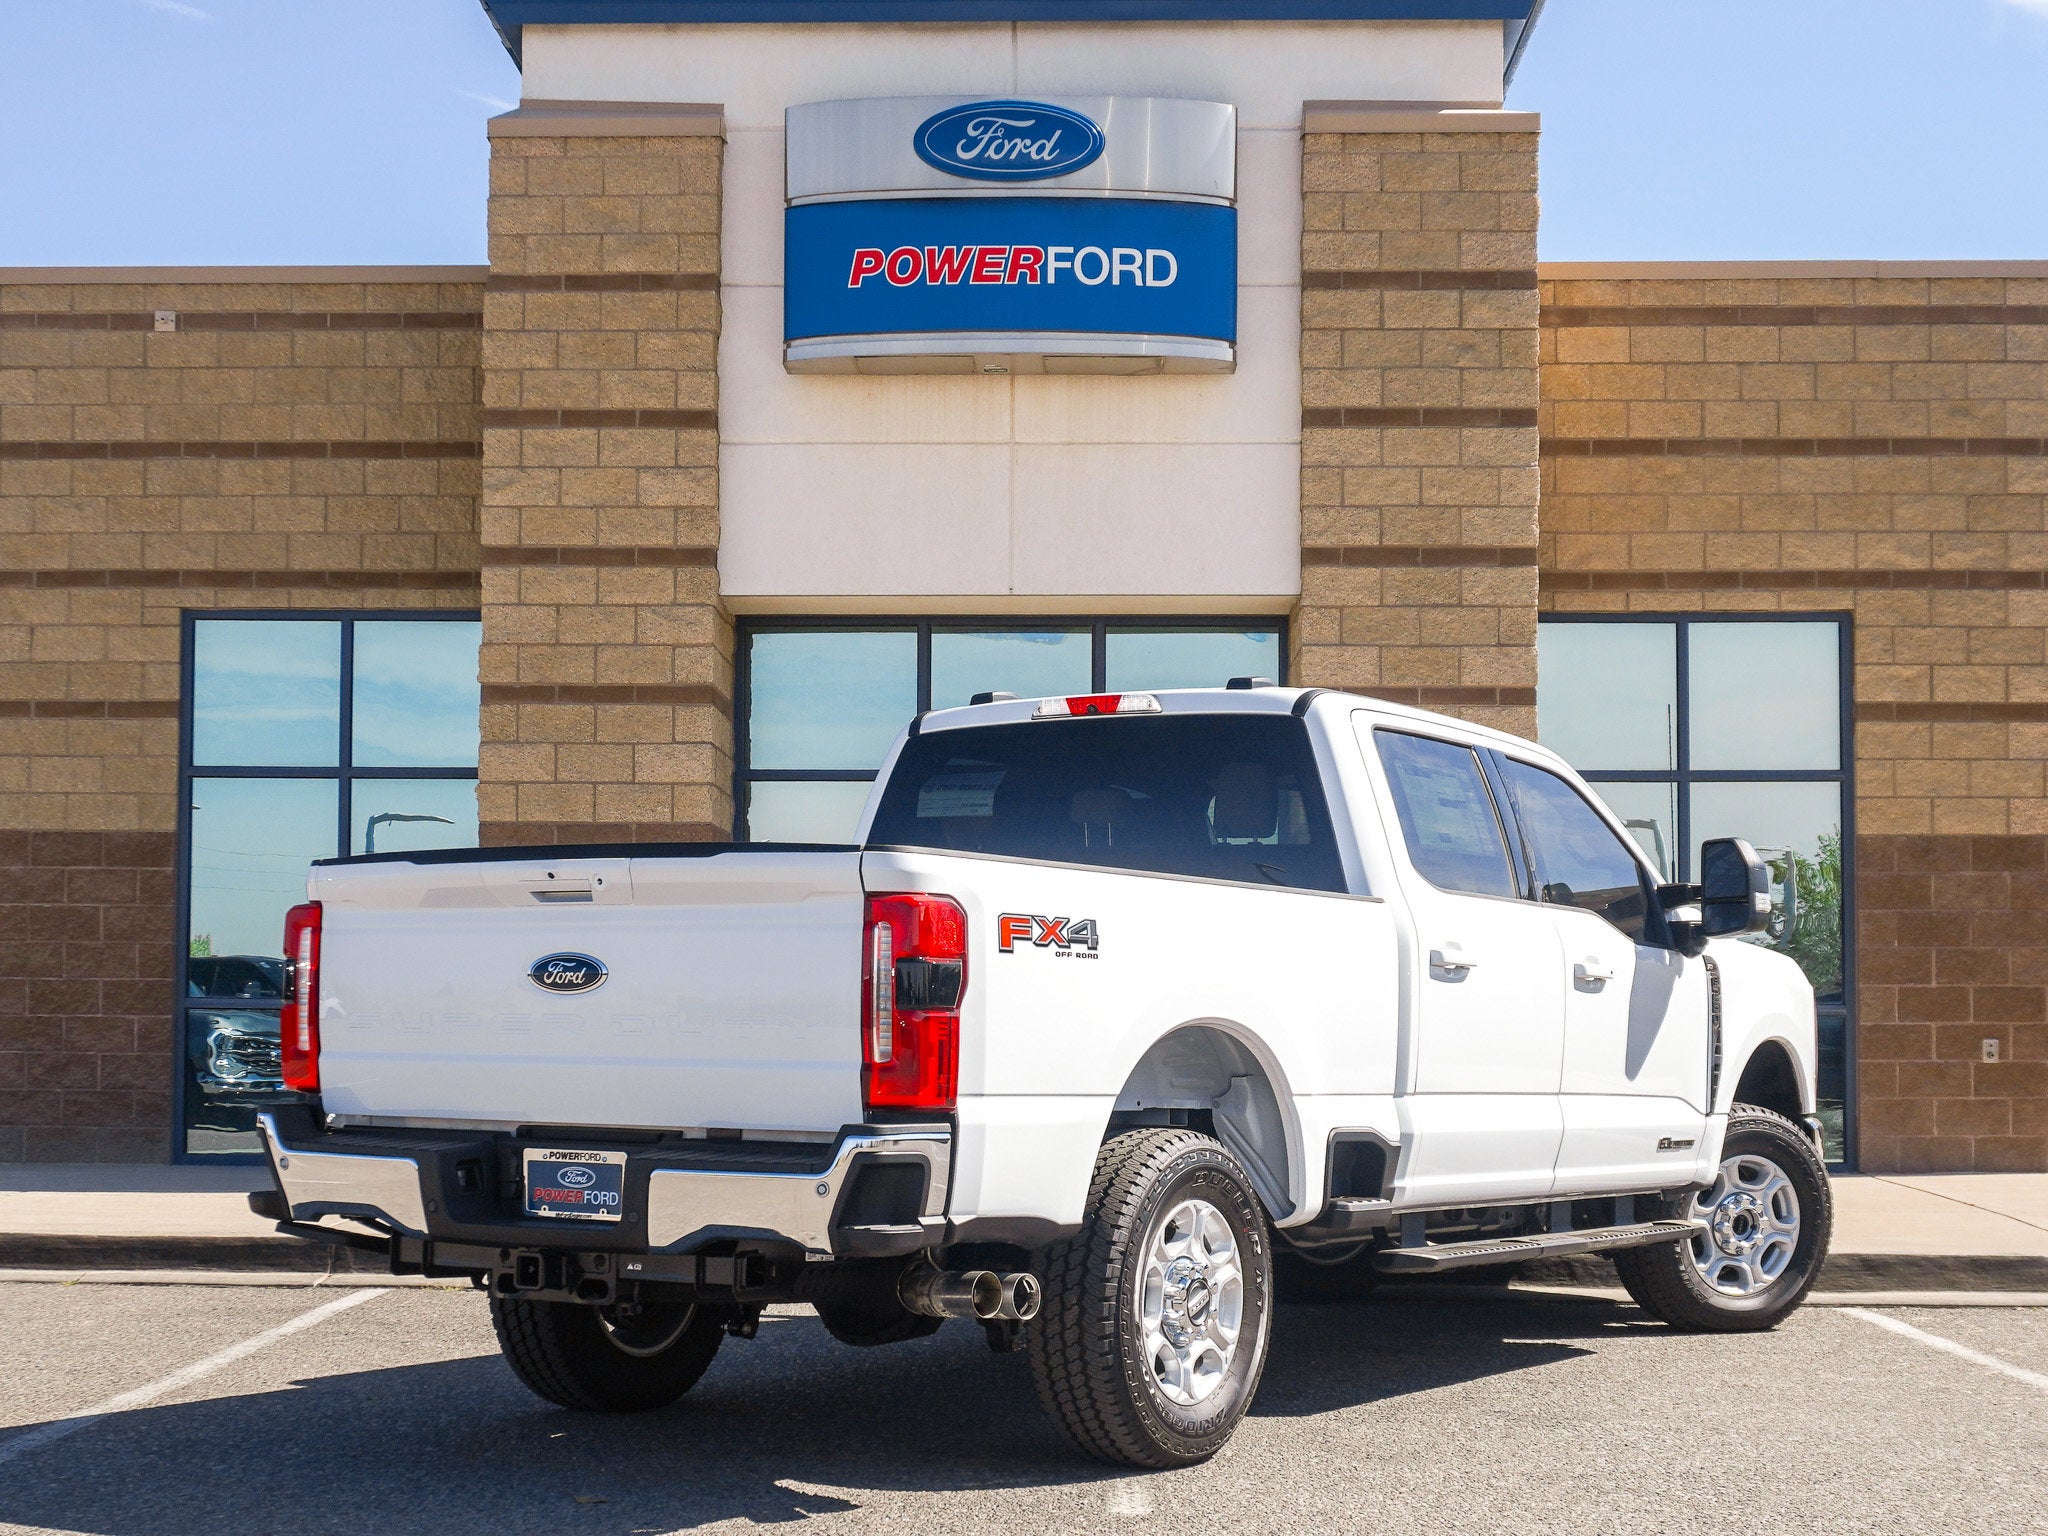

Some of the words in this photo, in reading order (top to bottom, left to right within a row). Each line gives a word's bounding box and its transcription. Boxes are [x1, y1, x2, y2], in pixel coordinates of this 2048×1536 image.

[955, 116, 1063, 162] Ford
[998, 912, 1098, 953] FX4
[1075, 952, 1099, 960] ROAD
[543, 960, 587, 984] Ford
[344, 1011, 585, 1036] SUPER
[549, 1151, 601, 1161] POWERFORD
[565, 1170, 588, 1183] Ford
[534, 1187, 618, 1205] POWERFORD
